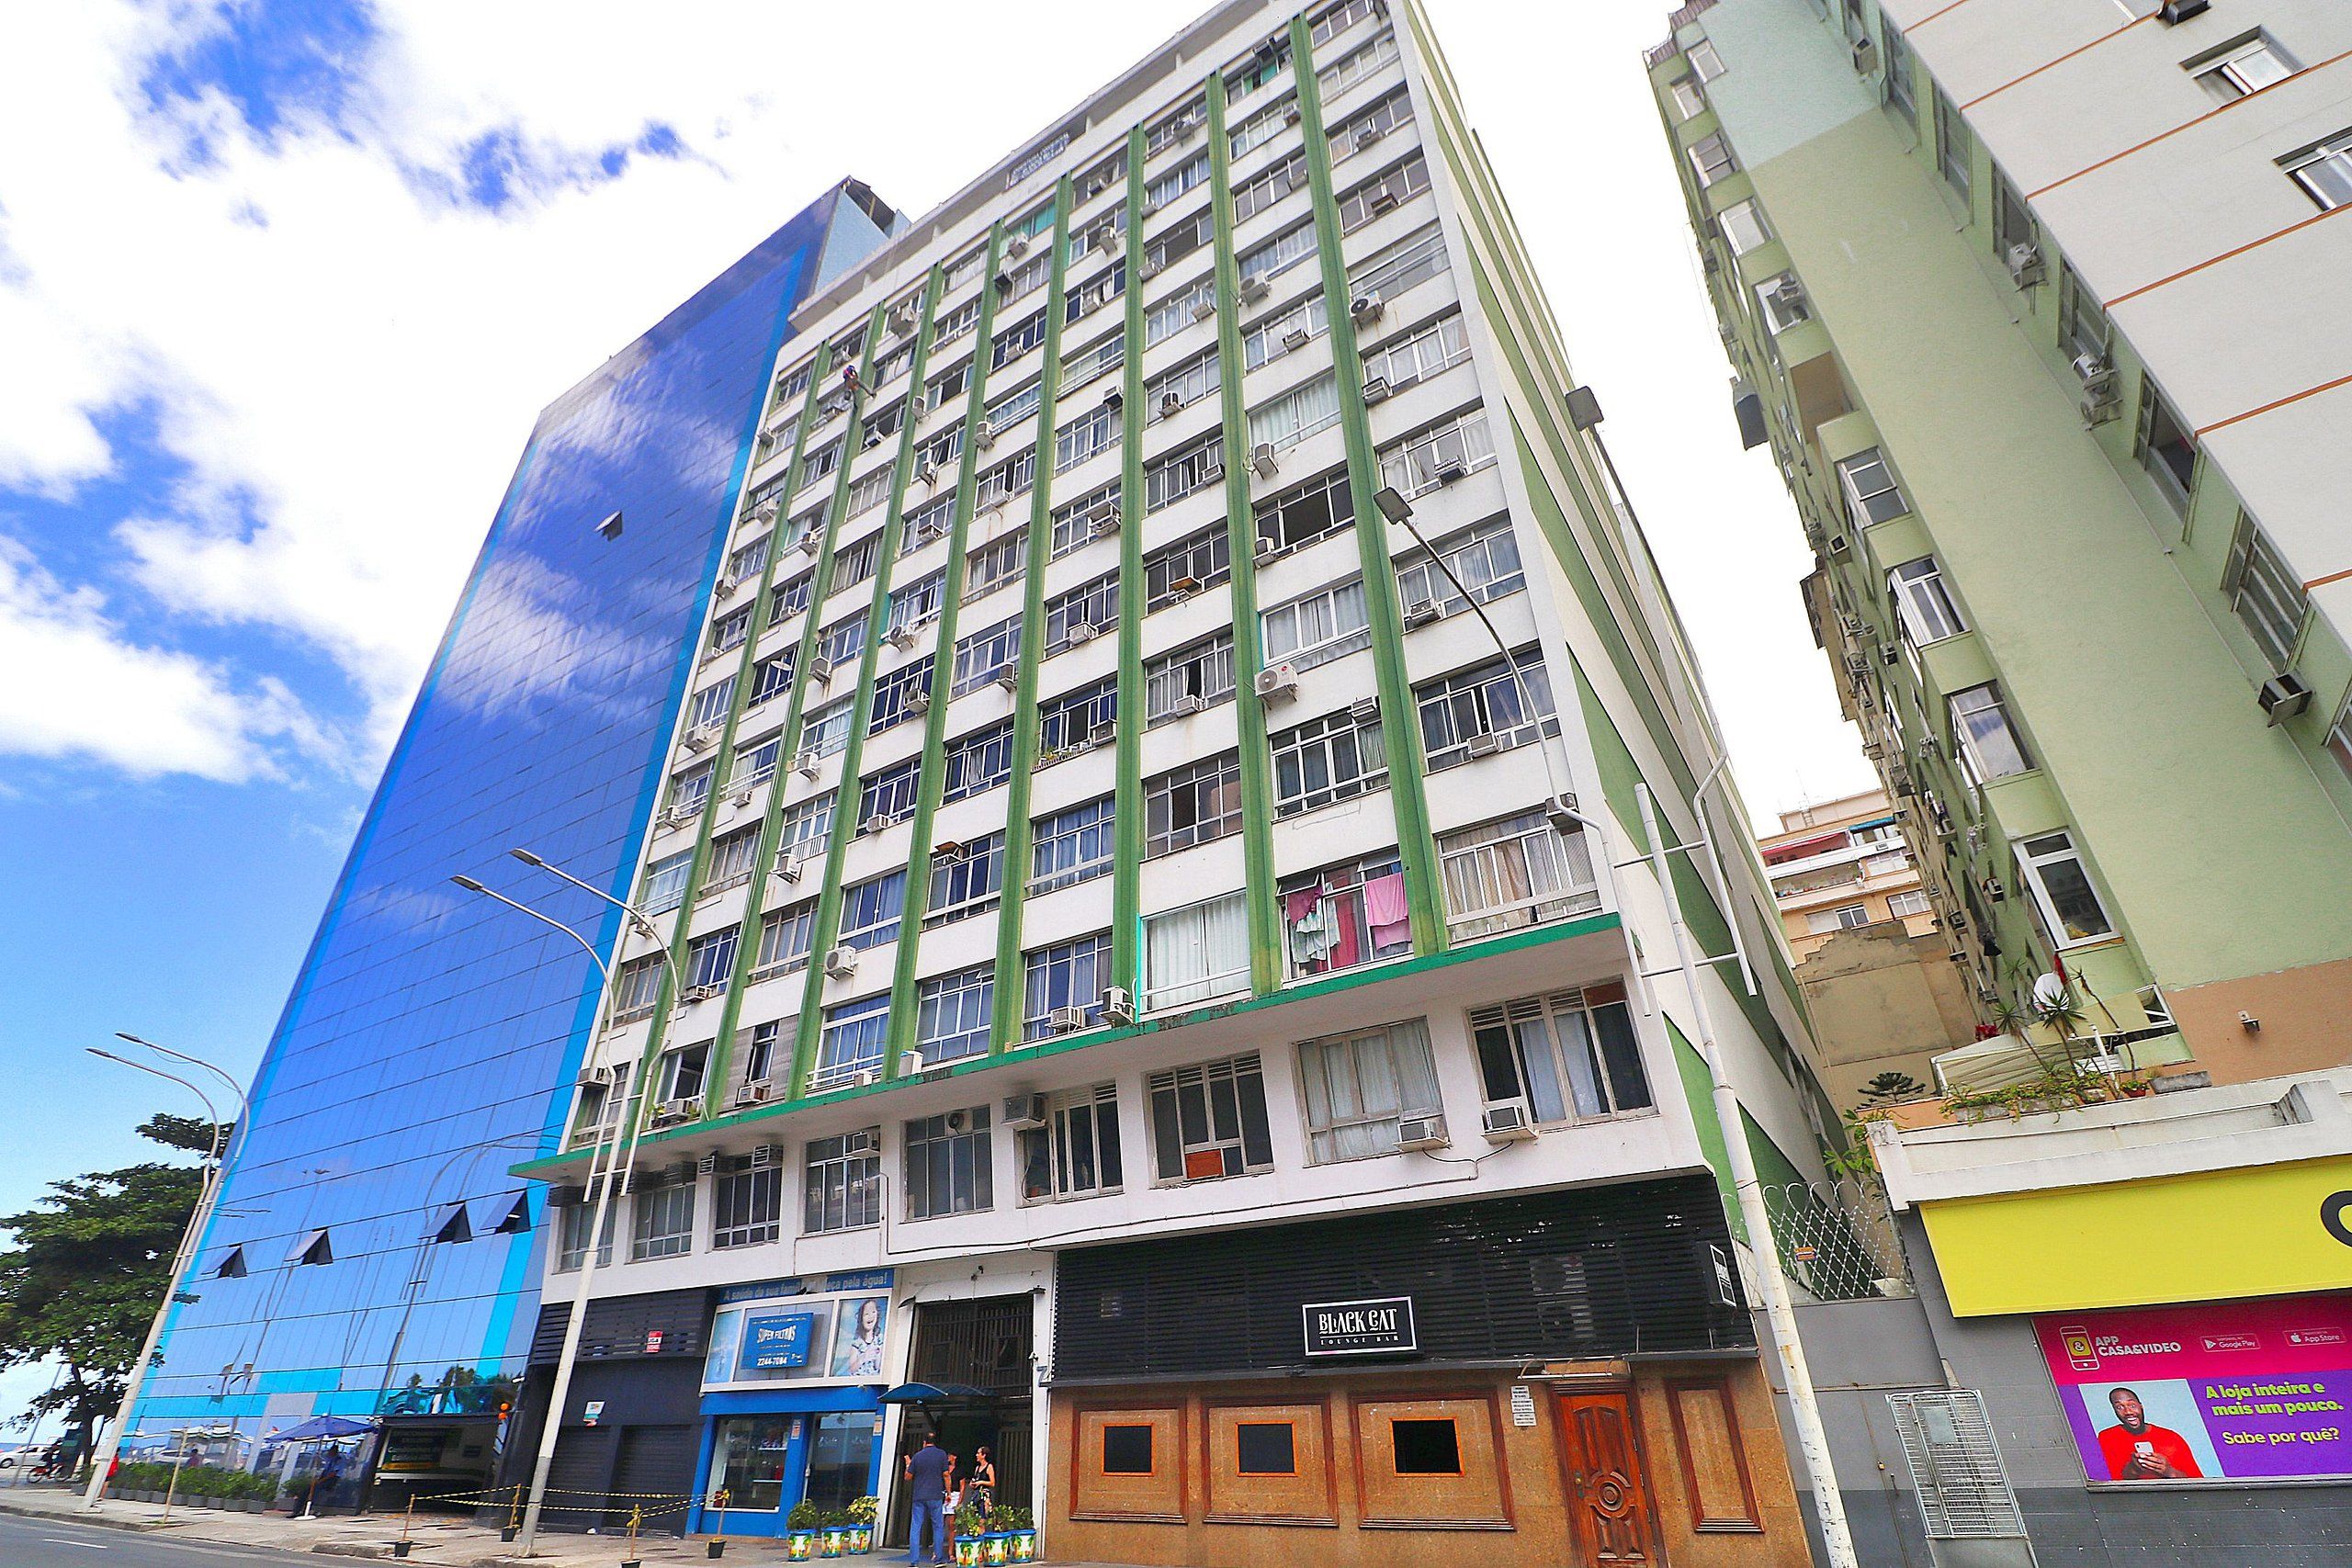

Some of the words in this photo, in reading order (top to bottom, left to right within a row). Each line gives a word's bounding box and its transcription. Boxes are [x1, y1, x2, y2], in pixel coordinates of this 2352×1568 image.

[842, 1275, 861, 1291] pela
[863, 1271, 888, 1289] água!
[1318, 1310, 1367, 1335] BLACK
[1368, 1308, 1397, 1331] CAT
[1320, 1337, 1366, 1346] LOUNGE
[2095, 1336, 2120, 1347] APP
[2098, 1341, 2182, 1357] CASA&VIDEO
[2219, 1340, 2242, 1348] Google
[2242, 1339, 2256, 1348] Play
[2206, 1384, 2220, 1399] A
[2219, 1383, 2253, 1401] loja
[2252, 1382, 2312, 1396] inteira
[2312, 1382, 2325, 1393] e
[2211, 1402, 2254, 1416] mais
[2255, 1403, 2284, 1415] um
[2284, 1400, 2345, 1416] pouco.
[2222, 1431, 2267, 1445] Sabe
[2267, 1432, 2297, 1446] por
[2300, 1427, 2340, 1445] quê?
